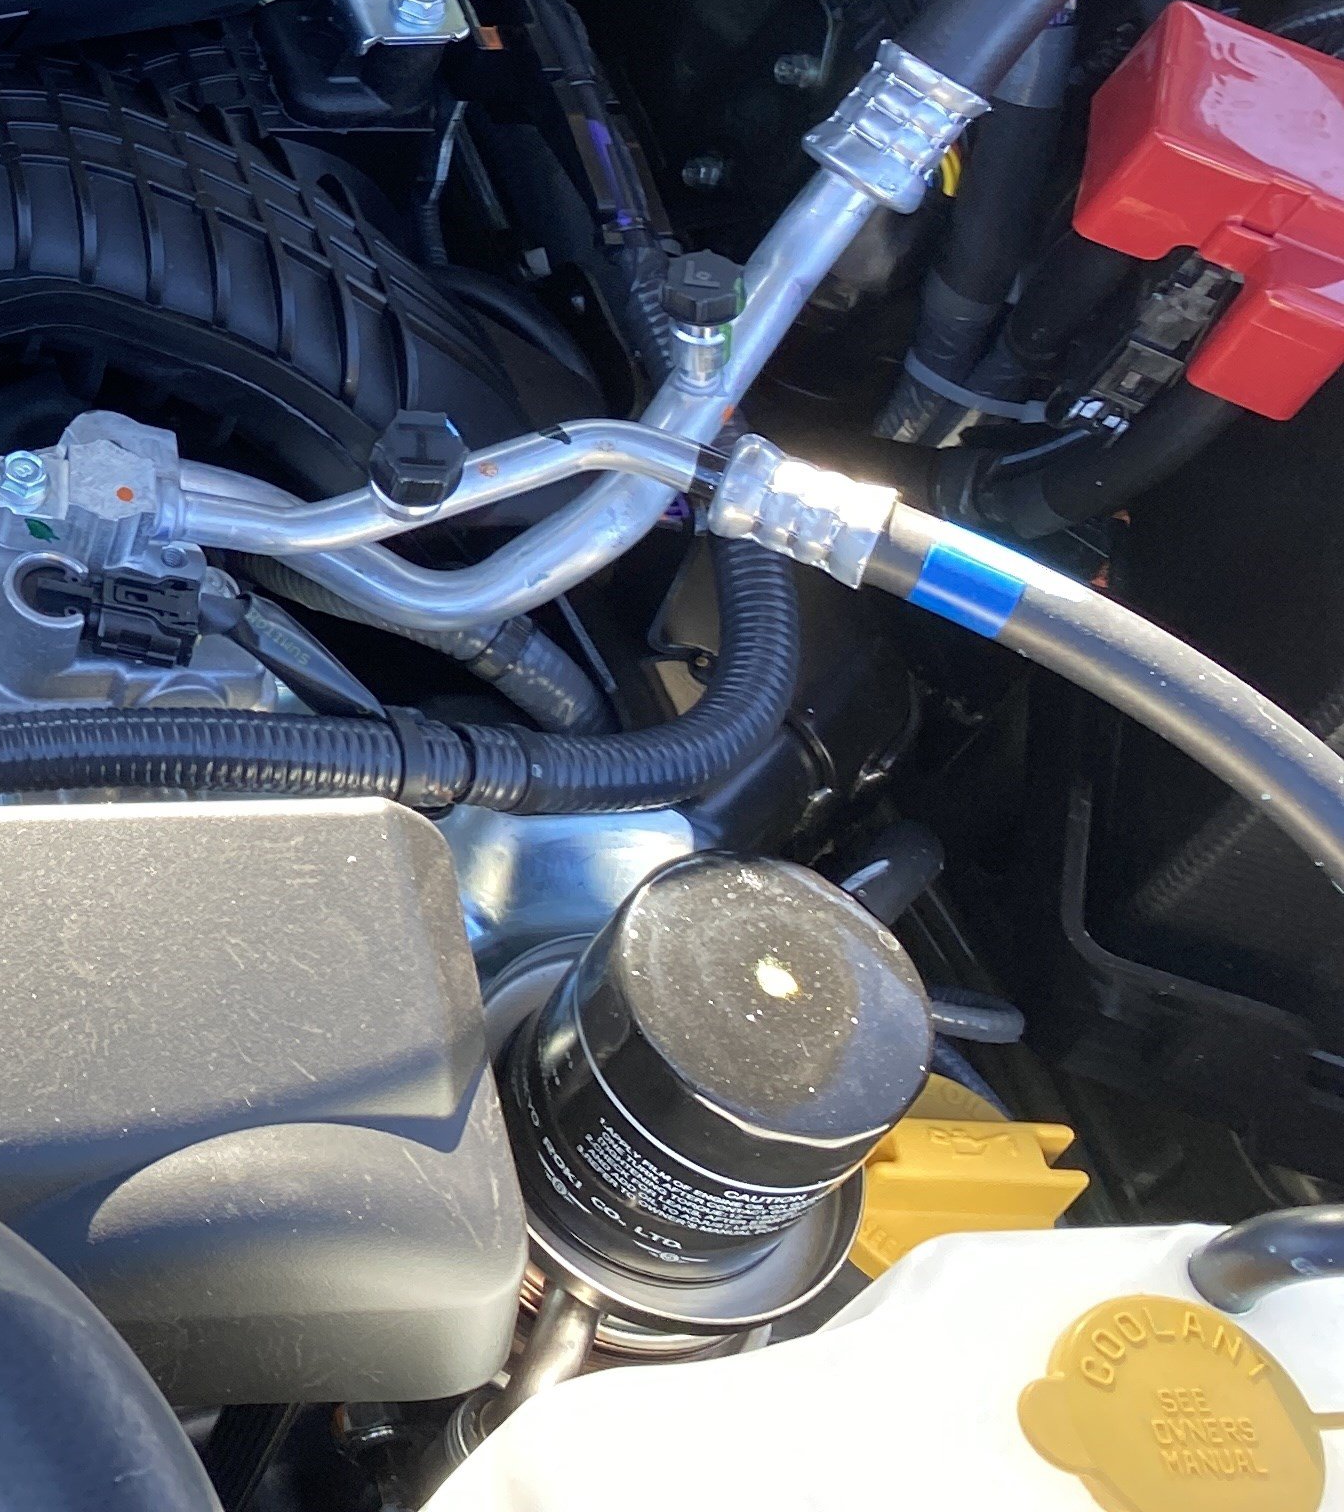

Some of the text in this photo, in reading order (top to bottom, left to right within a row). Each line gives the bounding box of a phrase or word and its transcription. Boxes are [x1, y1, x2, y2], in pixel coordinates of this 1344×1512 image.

[542, 1136, 583, 1189] ROKI
[587, 1148, 612, 1171] AND
[610, 1172, 637, 1194] ADD
[602, 1131, 625, 1156] ONE
[662, 1183, 705, 1205] AFTER
[641, 1159, 672, 1181] FILM
[672, 1179, 693, 1191] OF
[723, 1190, 807, 1204] CAUTION
[1080, 1306, 1275, 1388] COOLANT
[1158, 1386, 1213, 1414] SEE
[1158, 1447, 1272, 1476] MANUAL
